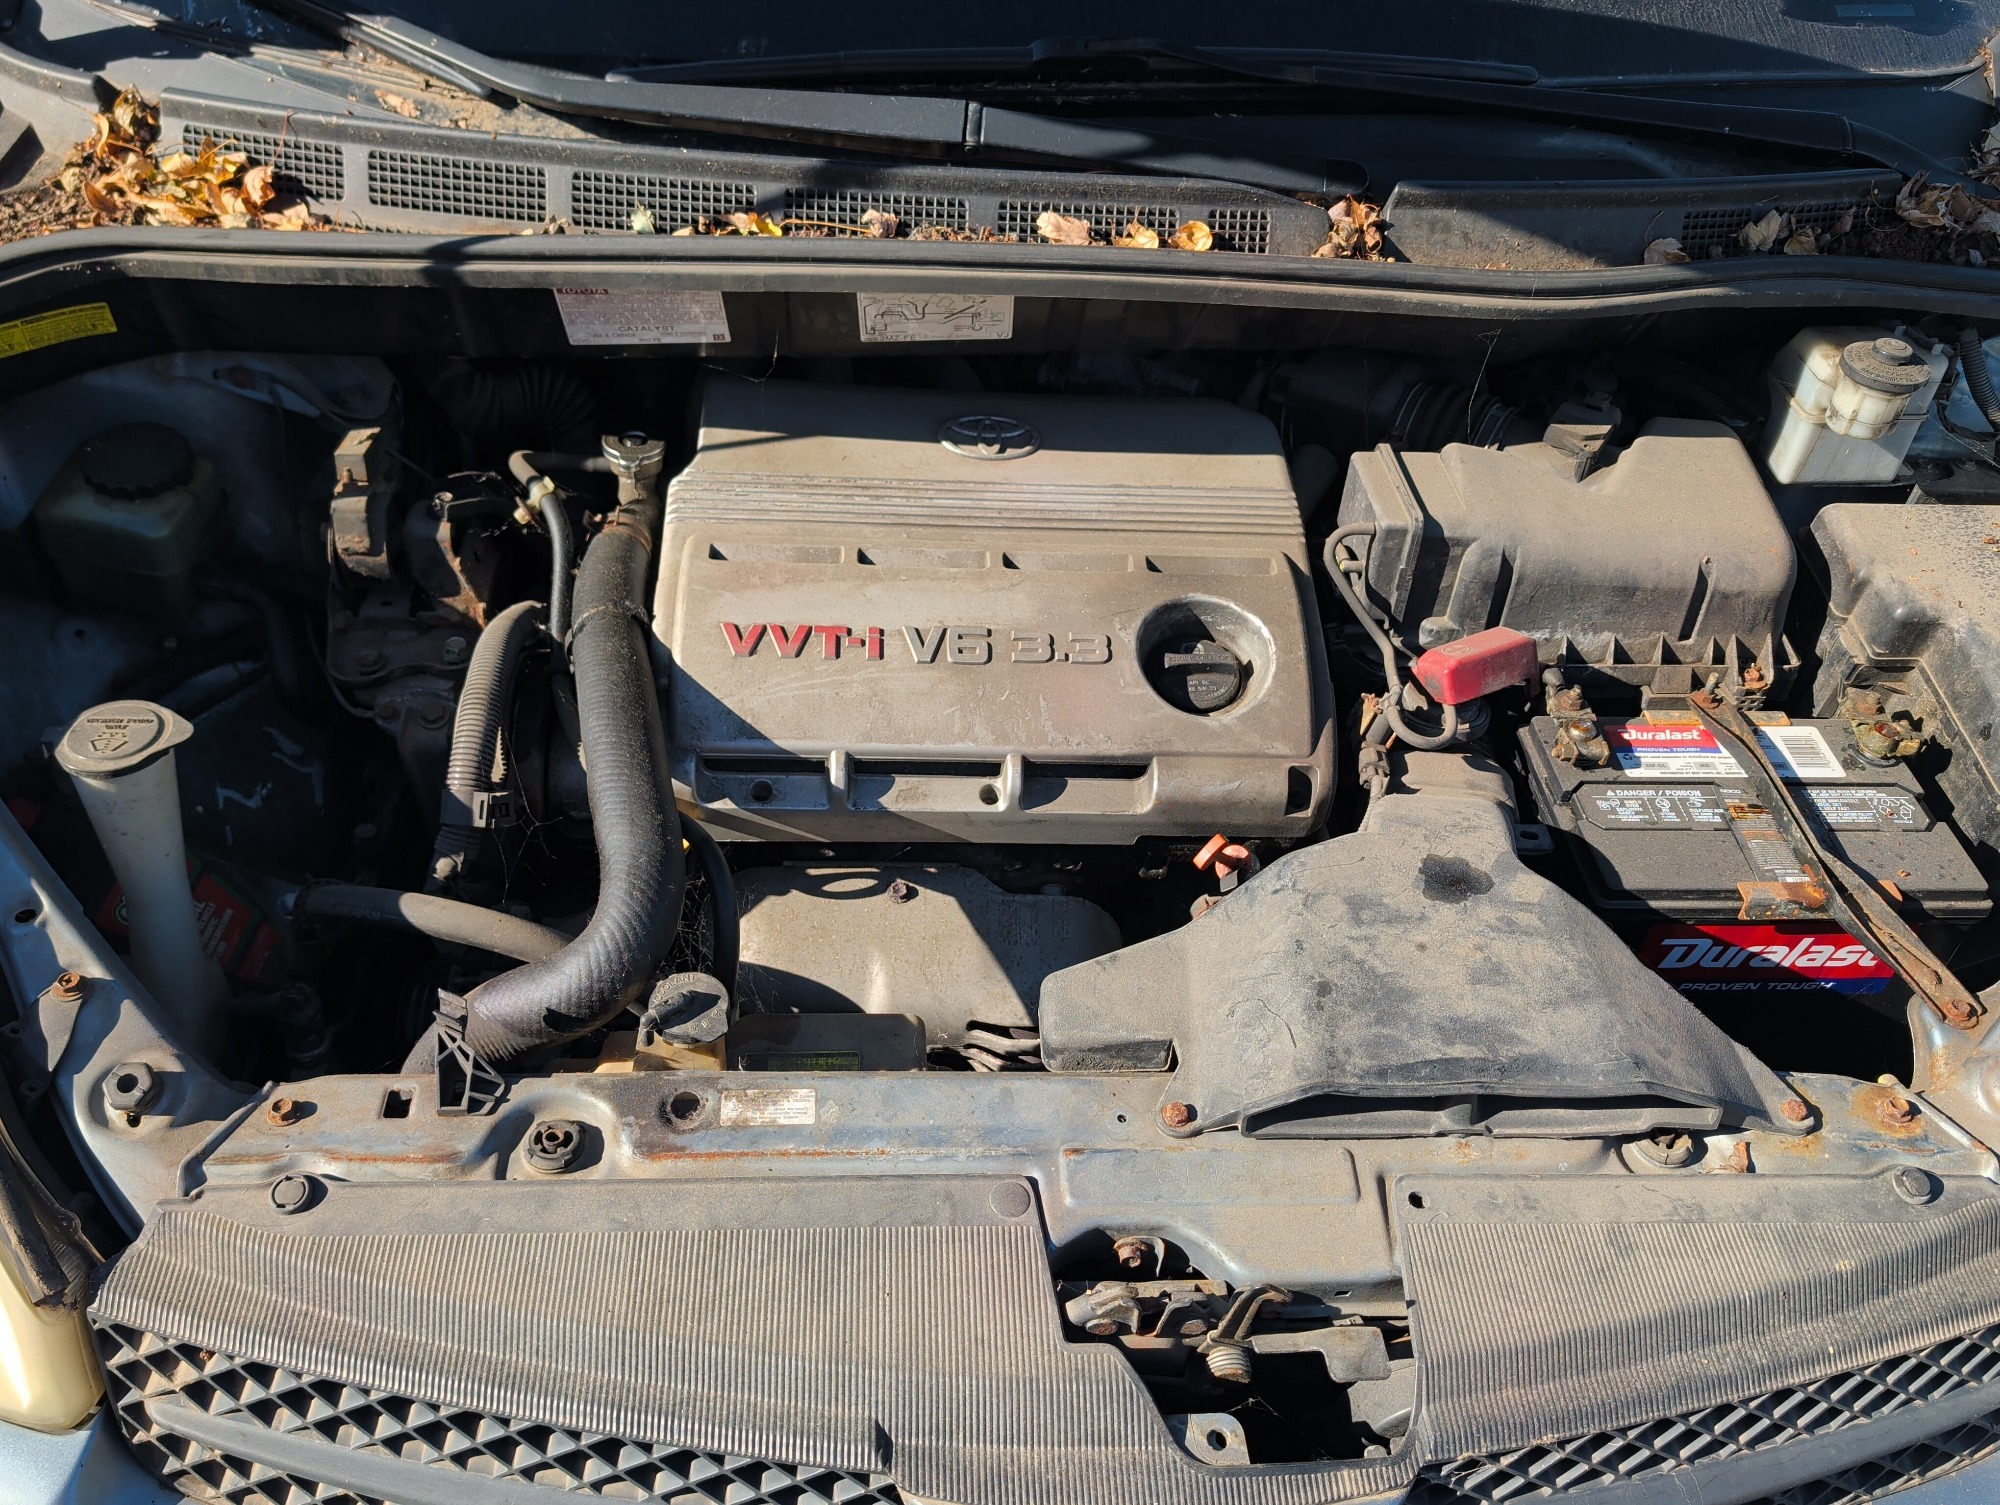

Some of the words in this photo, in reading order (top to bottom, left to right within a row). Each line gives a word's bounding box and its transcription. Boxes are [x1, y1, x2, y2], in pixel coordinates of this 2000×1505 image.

[720, 622, 885, 662] VVT-i
[901, 625, 992, 666] V6
[1010, 631, 1113, 665] 3.3
[1617, 729, 1702, 740] Duralast
[1658, 937, 1880, 969] Duralast
[653, 973, 698, 1003] COOLANT
[1678, 982, 1764, 991] PROVEN
[1767, 981, 1834, 990] TOUGH
